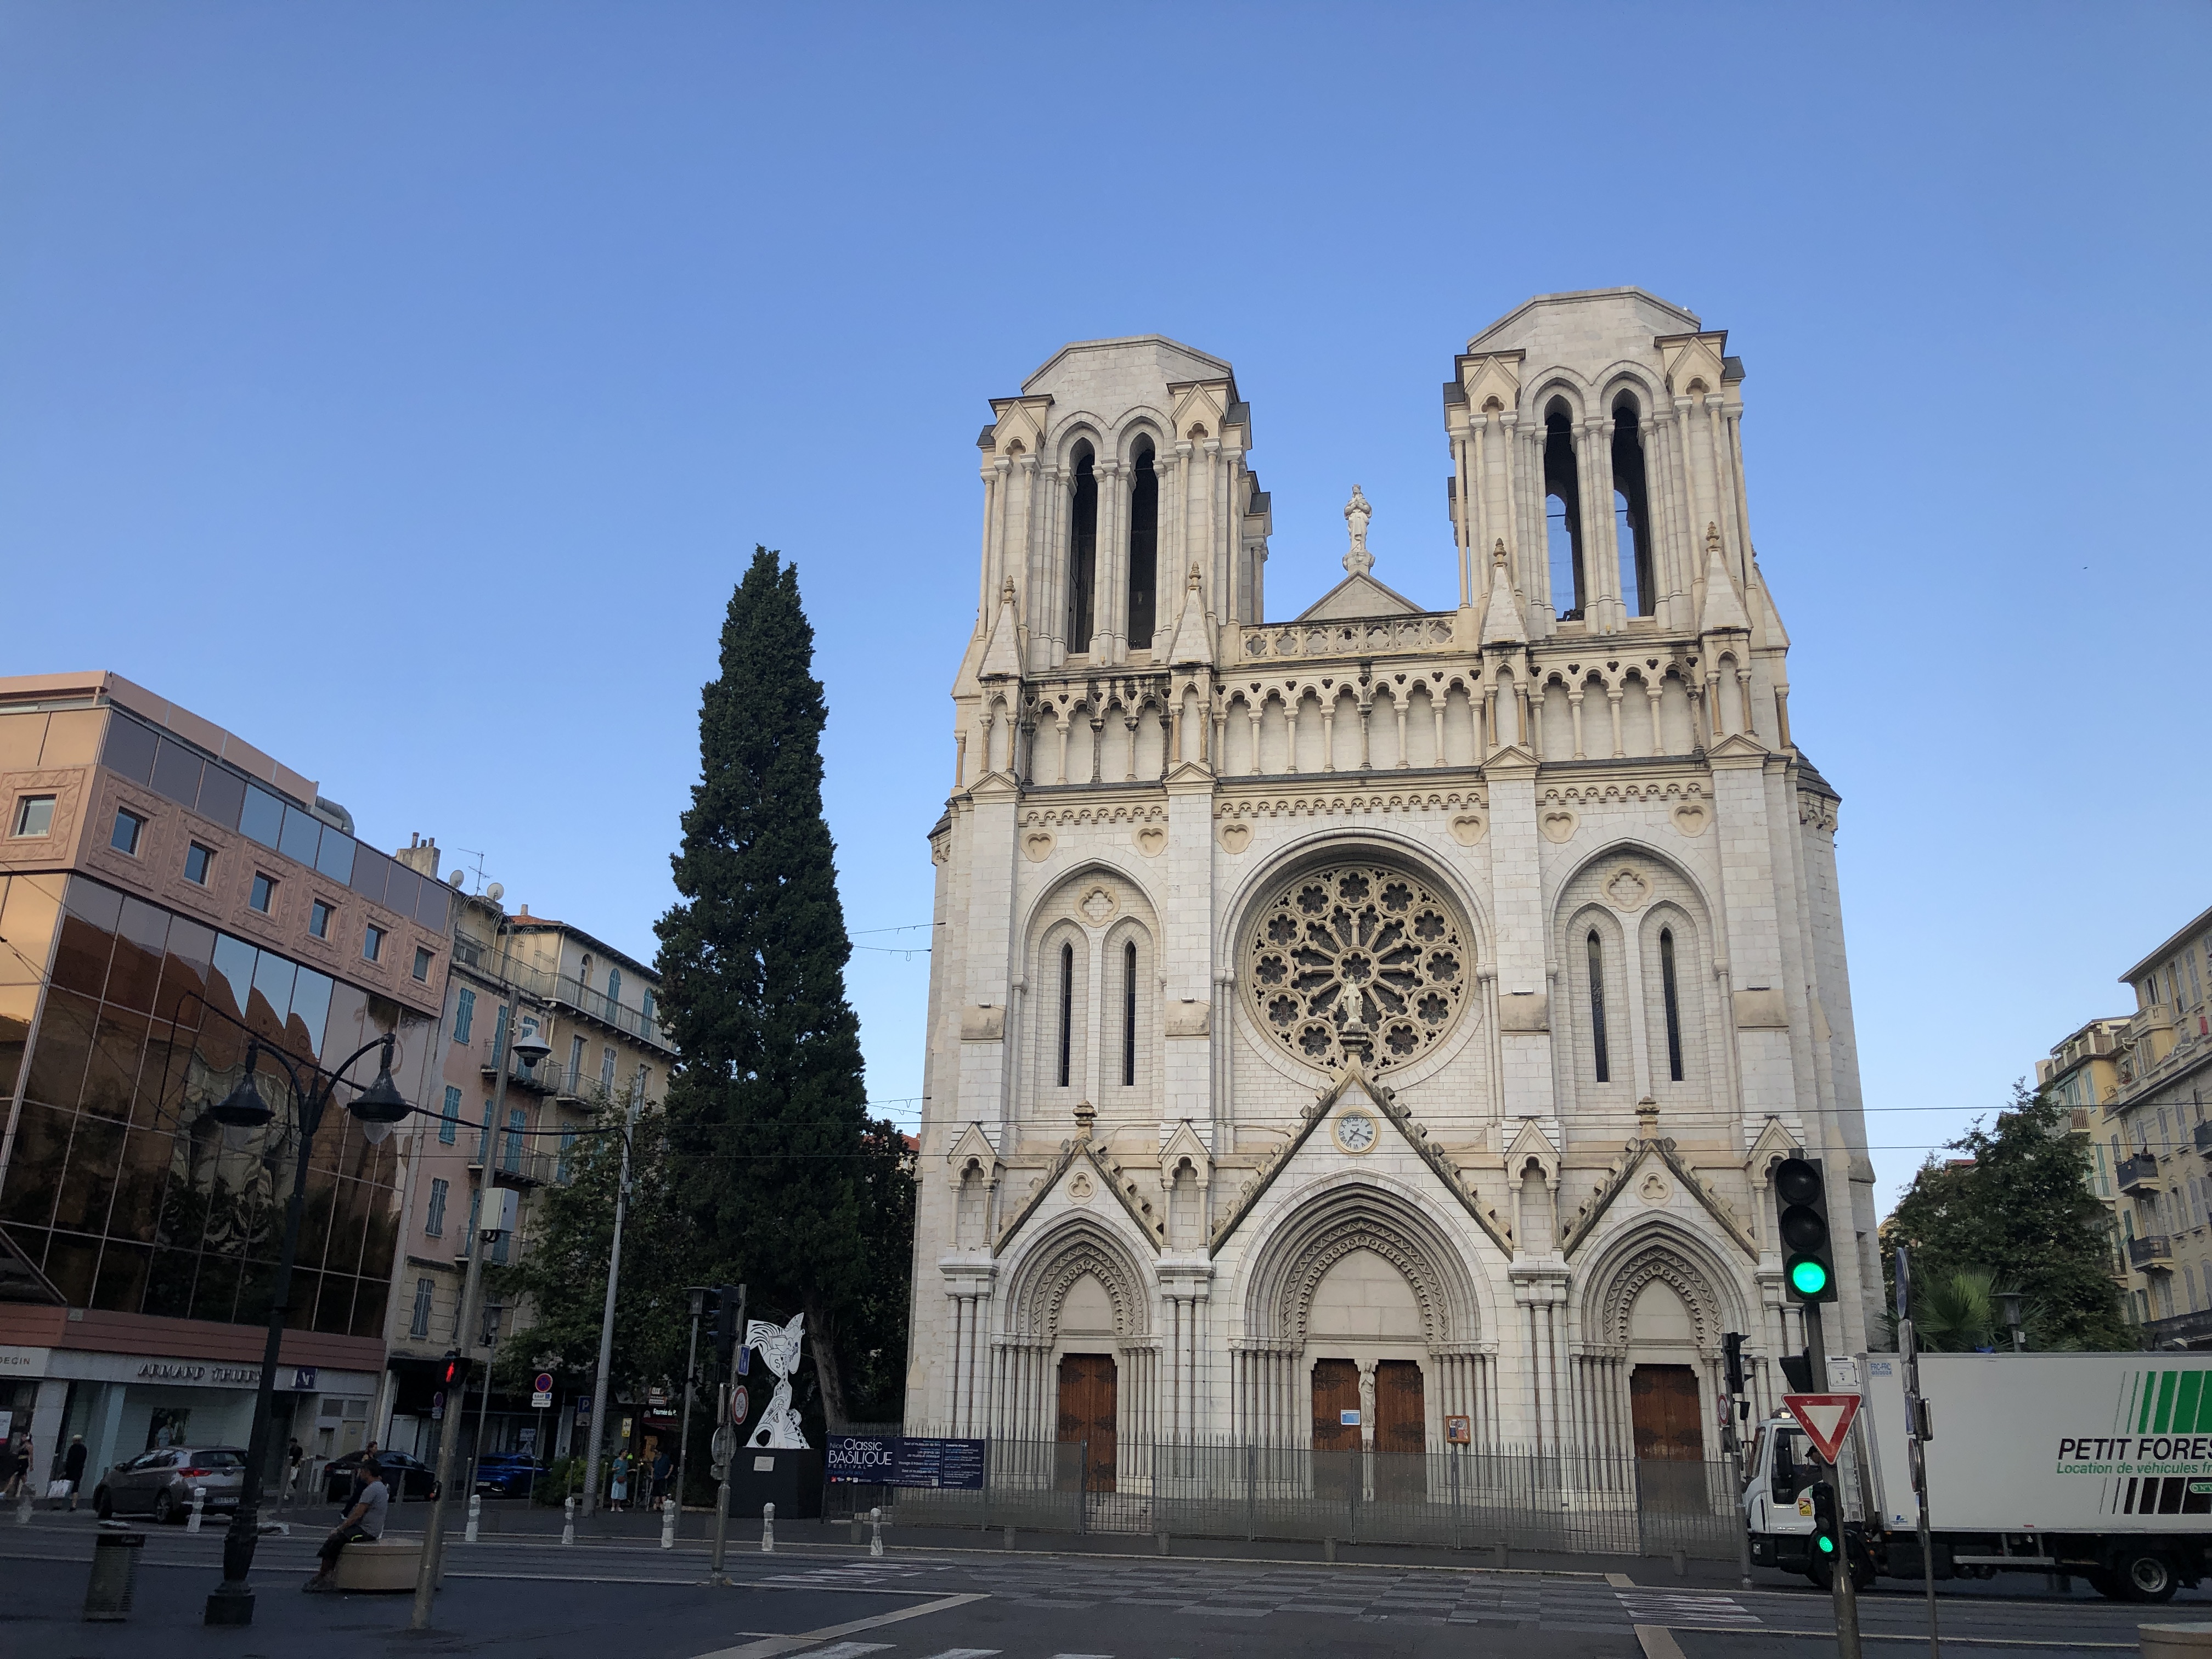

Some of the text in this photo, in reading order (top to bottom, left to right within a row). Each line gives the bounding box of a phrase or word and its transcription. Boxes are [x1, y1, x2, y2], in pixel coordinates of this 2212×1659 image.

[138, 1363, 205, 1380] ARMAND
[844, 1438, 883, 1451] Classic
[2058, 1438, 2212, 1460] PETIT FORE
[828, 1450, 893, 1467] BASILIQUE
[2057, 1462, 2112, 1474] Location
[2117, 1462, 2134, 1474] de
[2137, 1462, 2198, 1474] véhicules
